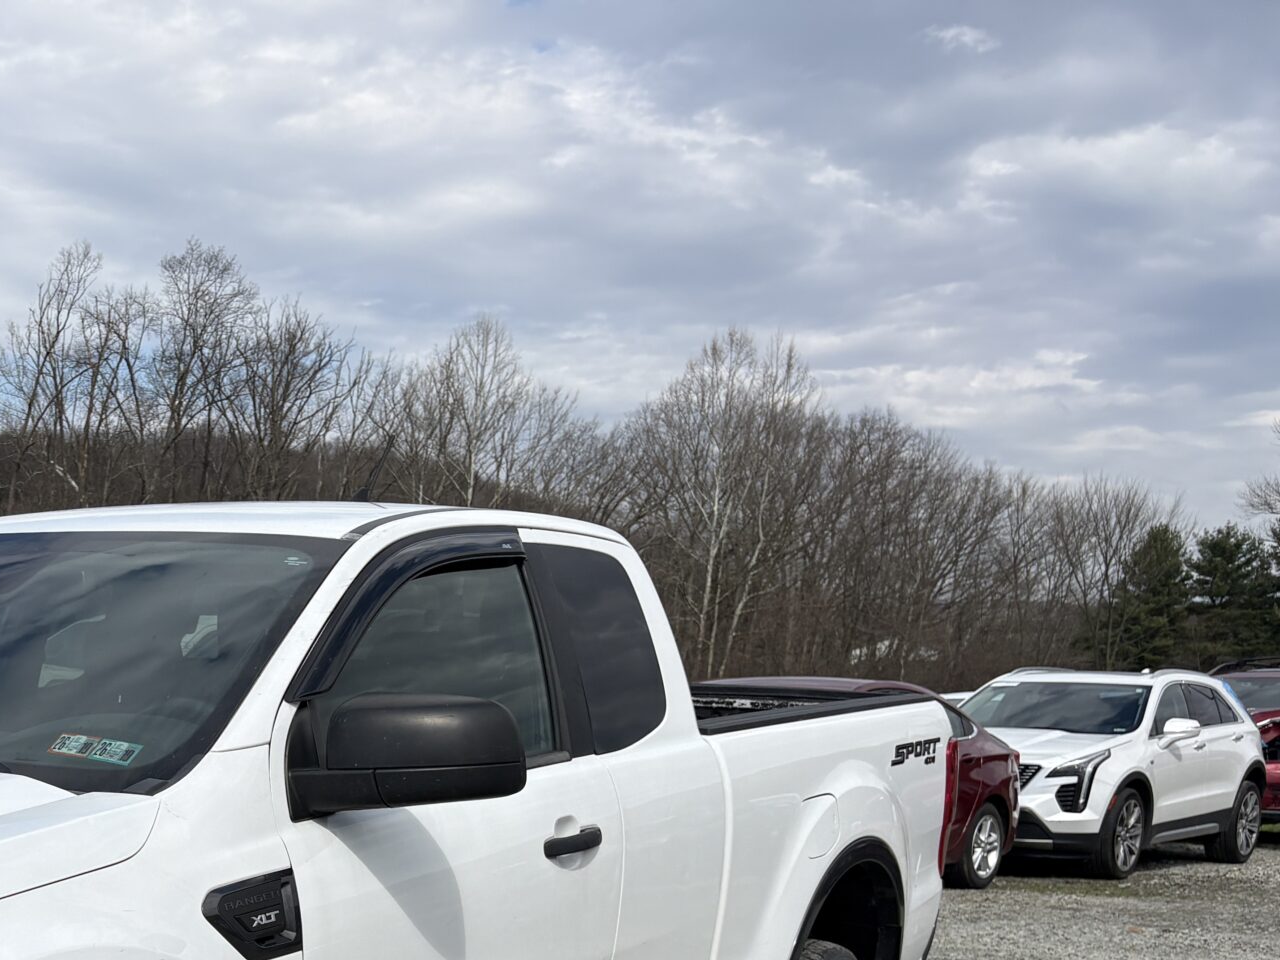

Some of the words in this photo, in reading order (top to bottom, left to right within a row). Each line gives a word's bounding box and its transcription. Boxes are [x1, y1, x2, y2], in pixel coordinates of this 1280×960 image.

[53, 736, 71, 750] 26
[94, 741, 112, 756] 26
[891, 737, 940, 767] SPORT
[250, 909, 280, 928] XLT
